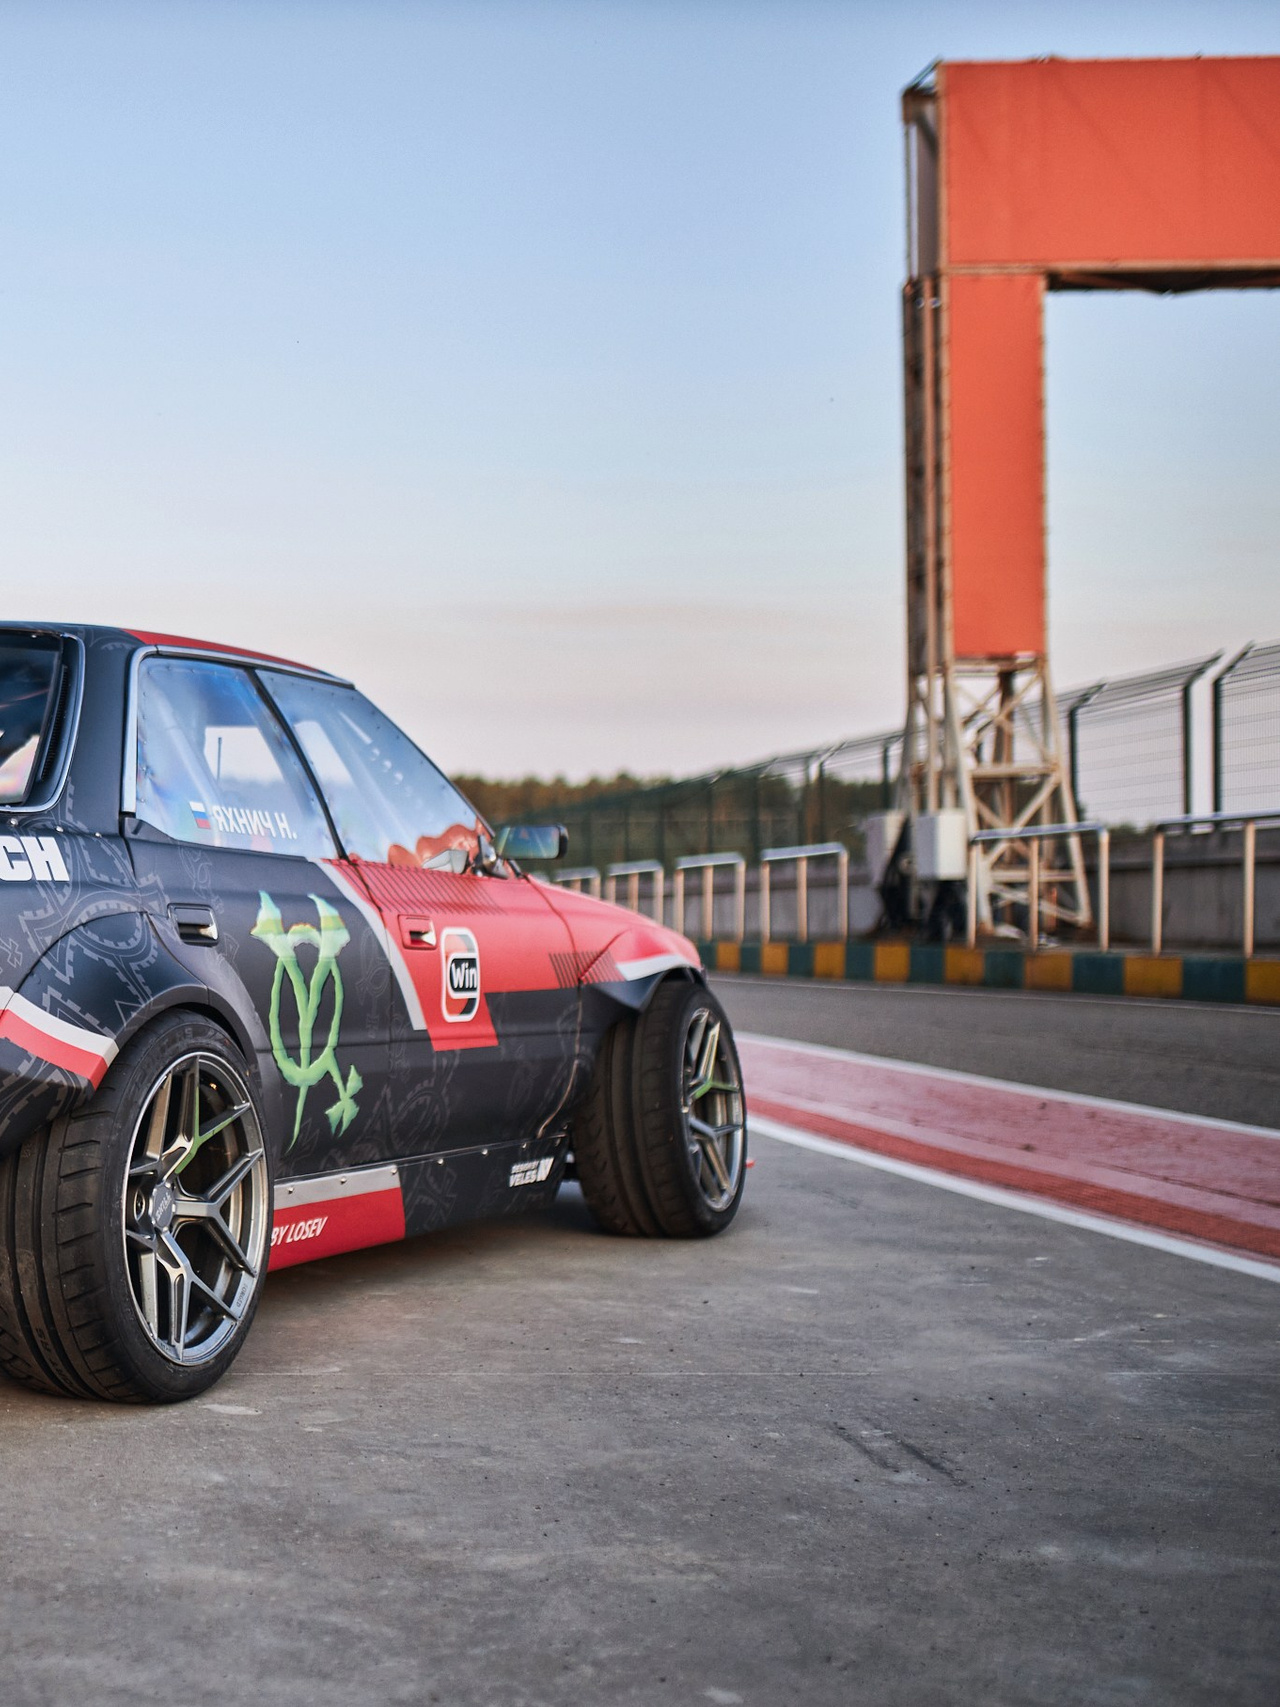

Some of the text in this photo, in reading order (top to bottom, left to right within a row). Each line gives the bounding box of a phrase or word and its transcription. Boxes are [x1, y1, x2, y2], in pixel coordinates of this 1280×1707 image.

[212, 805, 297, 840] ЯХНИЧ Н.
[451, 962, 477, 989] Win
[270, 1216, 328, 1247] BY LOSEV
